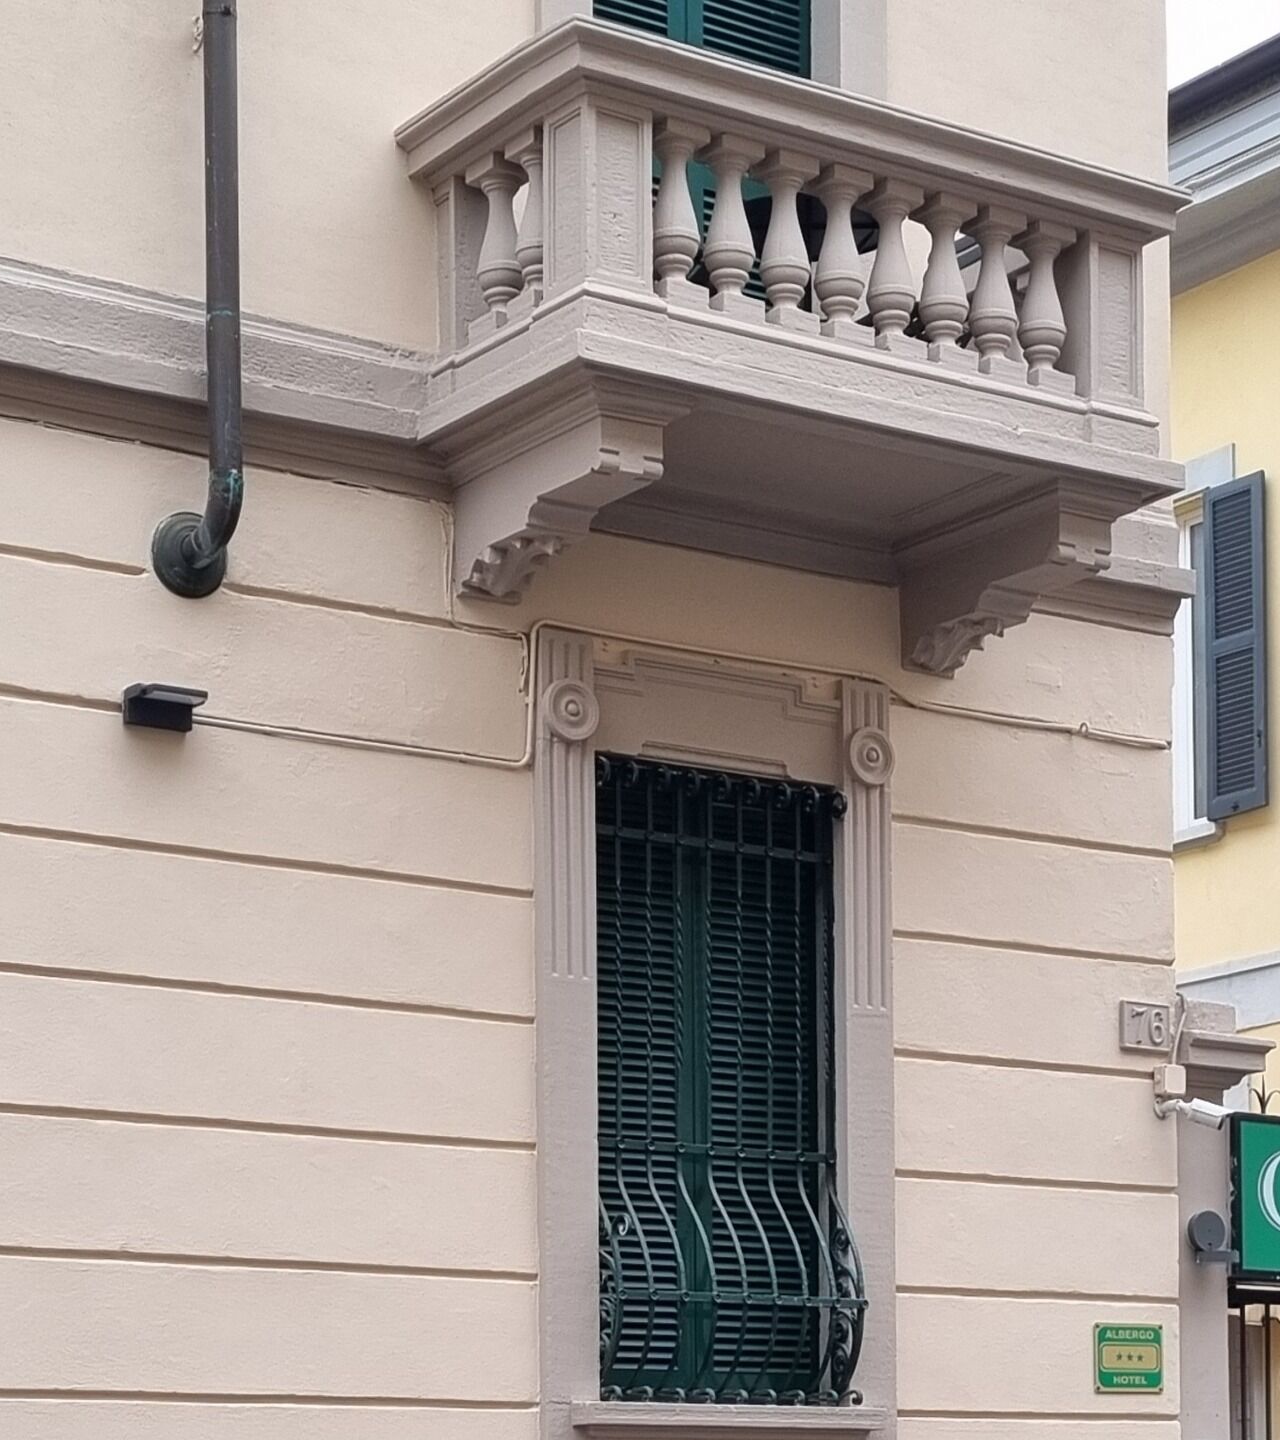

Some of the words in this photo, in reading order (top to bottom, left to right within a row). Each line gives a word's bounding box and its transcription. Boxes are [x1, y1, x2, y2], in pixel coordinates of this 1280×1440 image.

[1130, 1005, 1166, 1046] 76
[1105, 1329, 1155, 1340] ALBERGO
[1112, 1375, 1148, 1385] HOTEL
